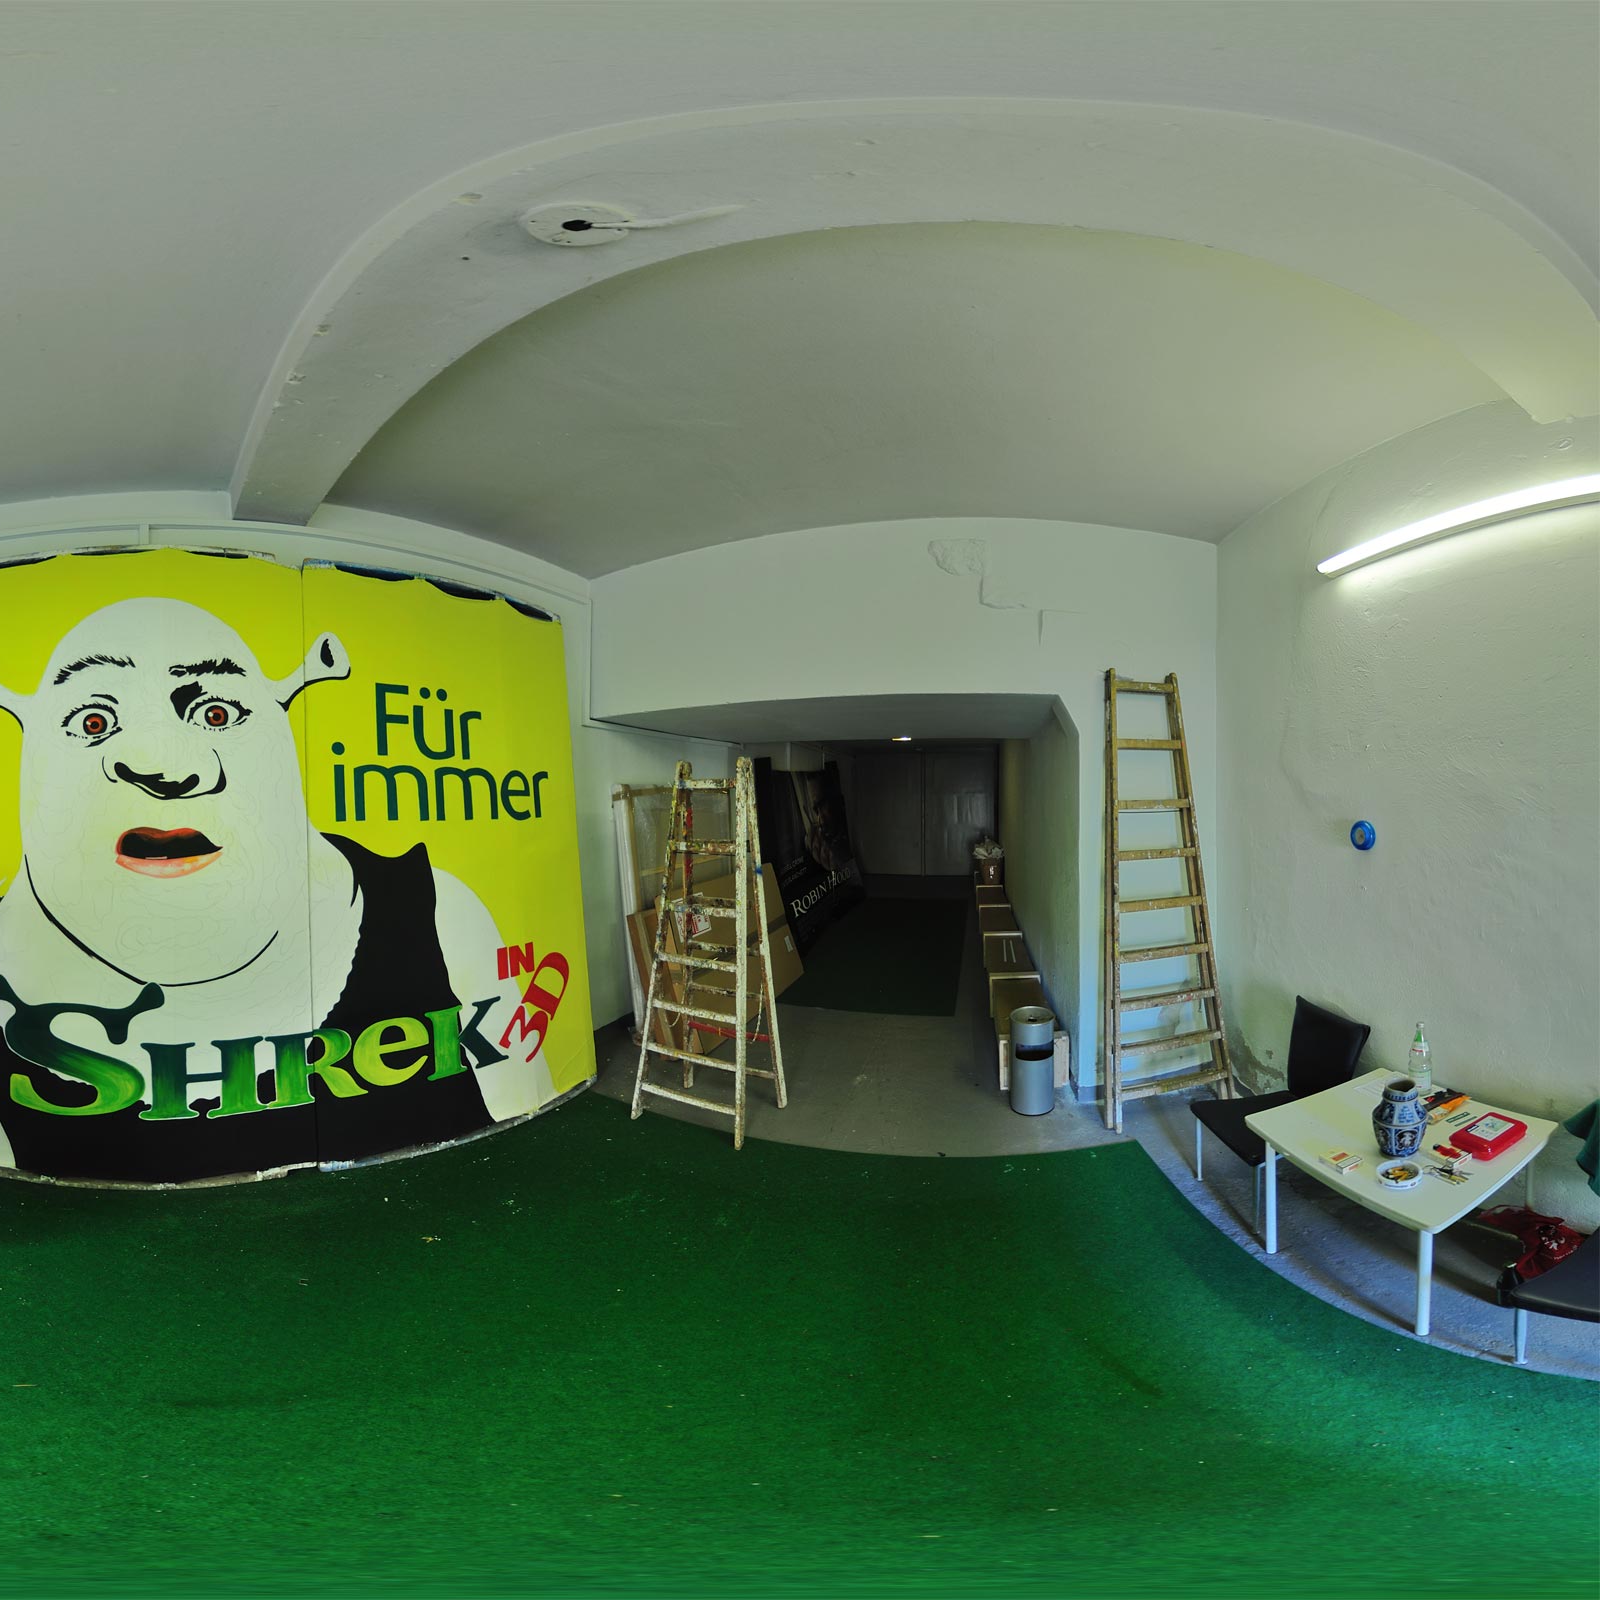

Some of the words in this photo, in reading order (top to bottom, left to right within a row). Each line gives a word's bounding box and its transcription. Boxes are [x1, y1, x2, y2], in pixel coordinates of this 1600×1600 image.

[375, 682, 482, 760] Für
[331, 741, 549, 822] immer
[789, 881, 827, 918] ROBIN
[827, 868, 851, 890] HOOD
[496, 941, 535, 981] IN
[498, 951, 570, 1063] 3D
